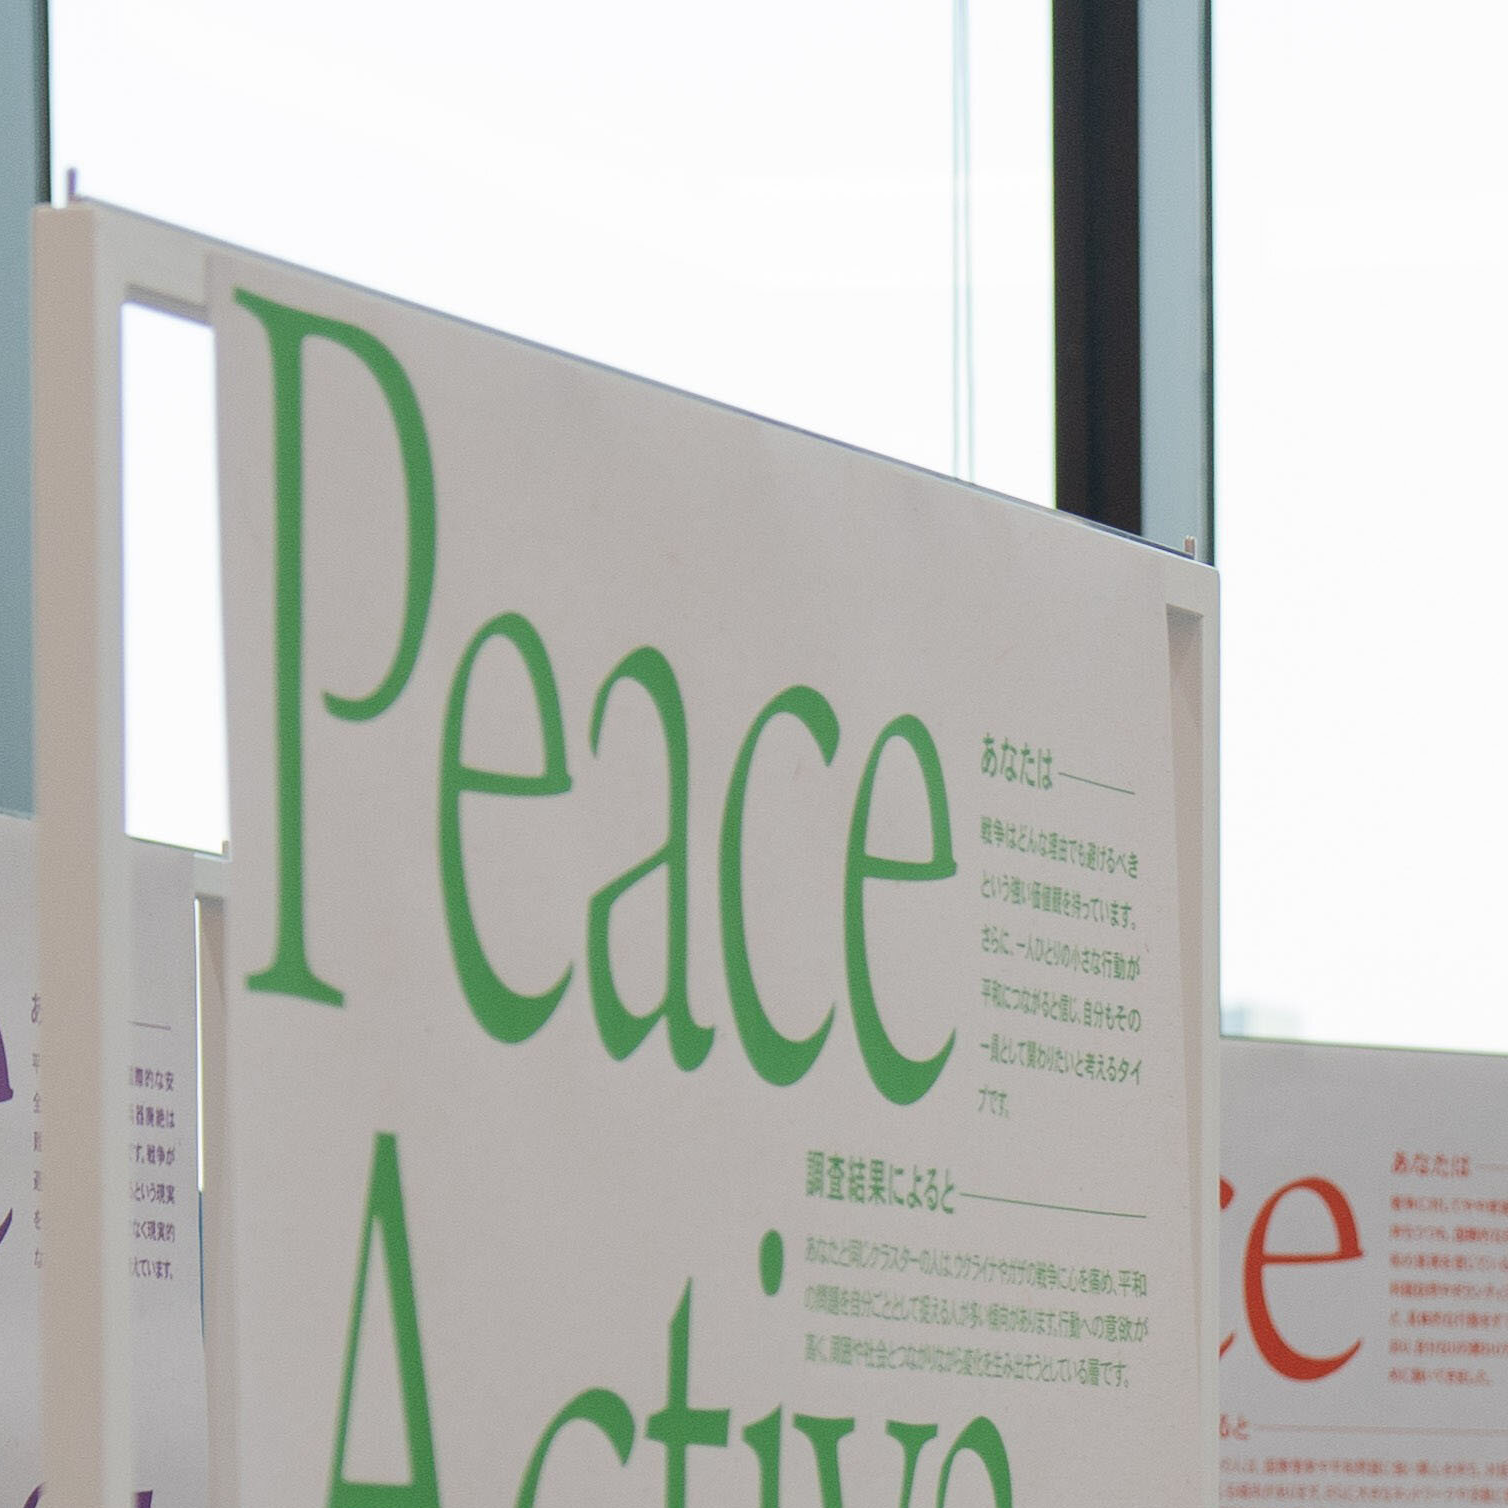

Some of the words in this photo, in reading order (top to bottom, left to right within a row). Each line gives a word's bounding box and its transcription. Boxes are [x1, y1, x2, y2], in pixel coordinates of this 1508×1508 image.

[235, 287, 957, 1106] Peace
[981, 733, 1053, 791] あなたは
[805, 1150, 955, 1215] 調査結果によると
